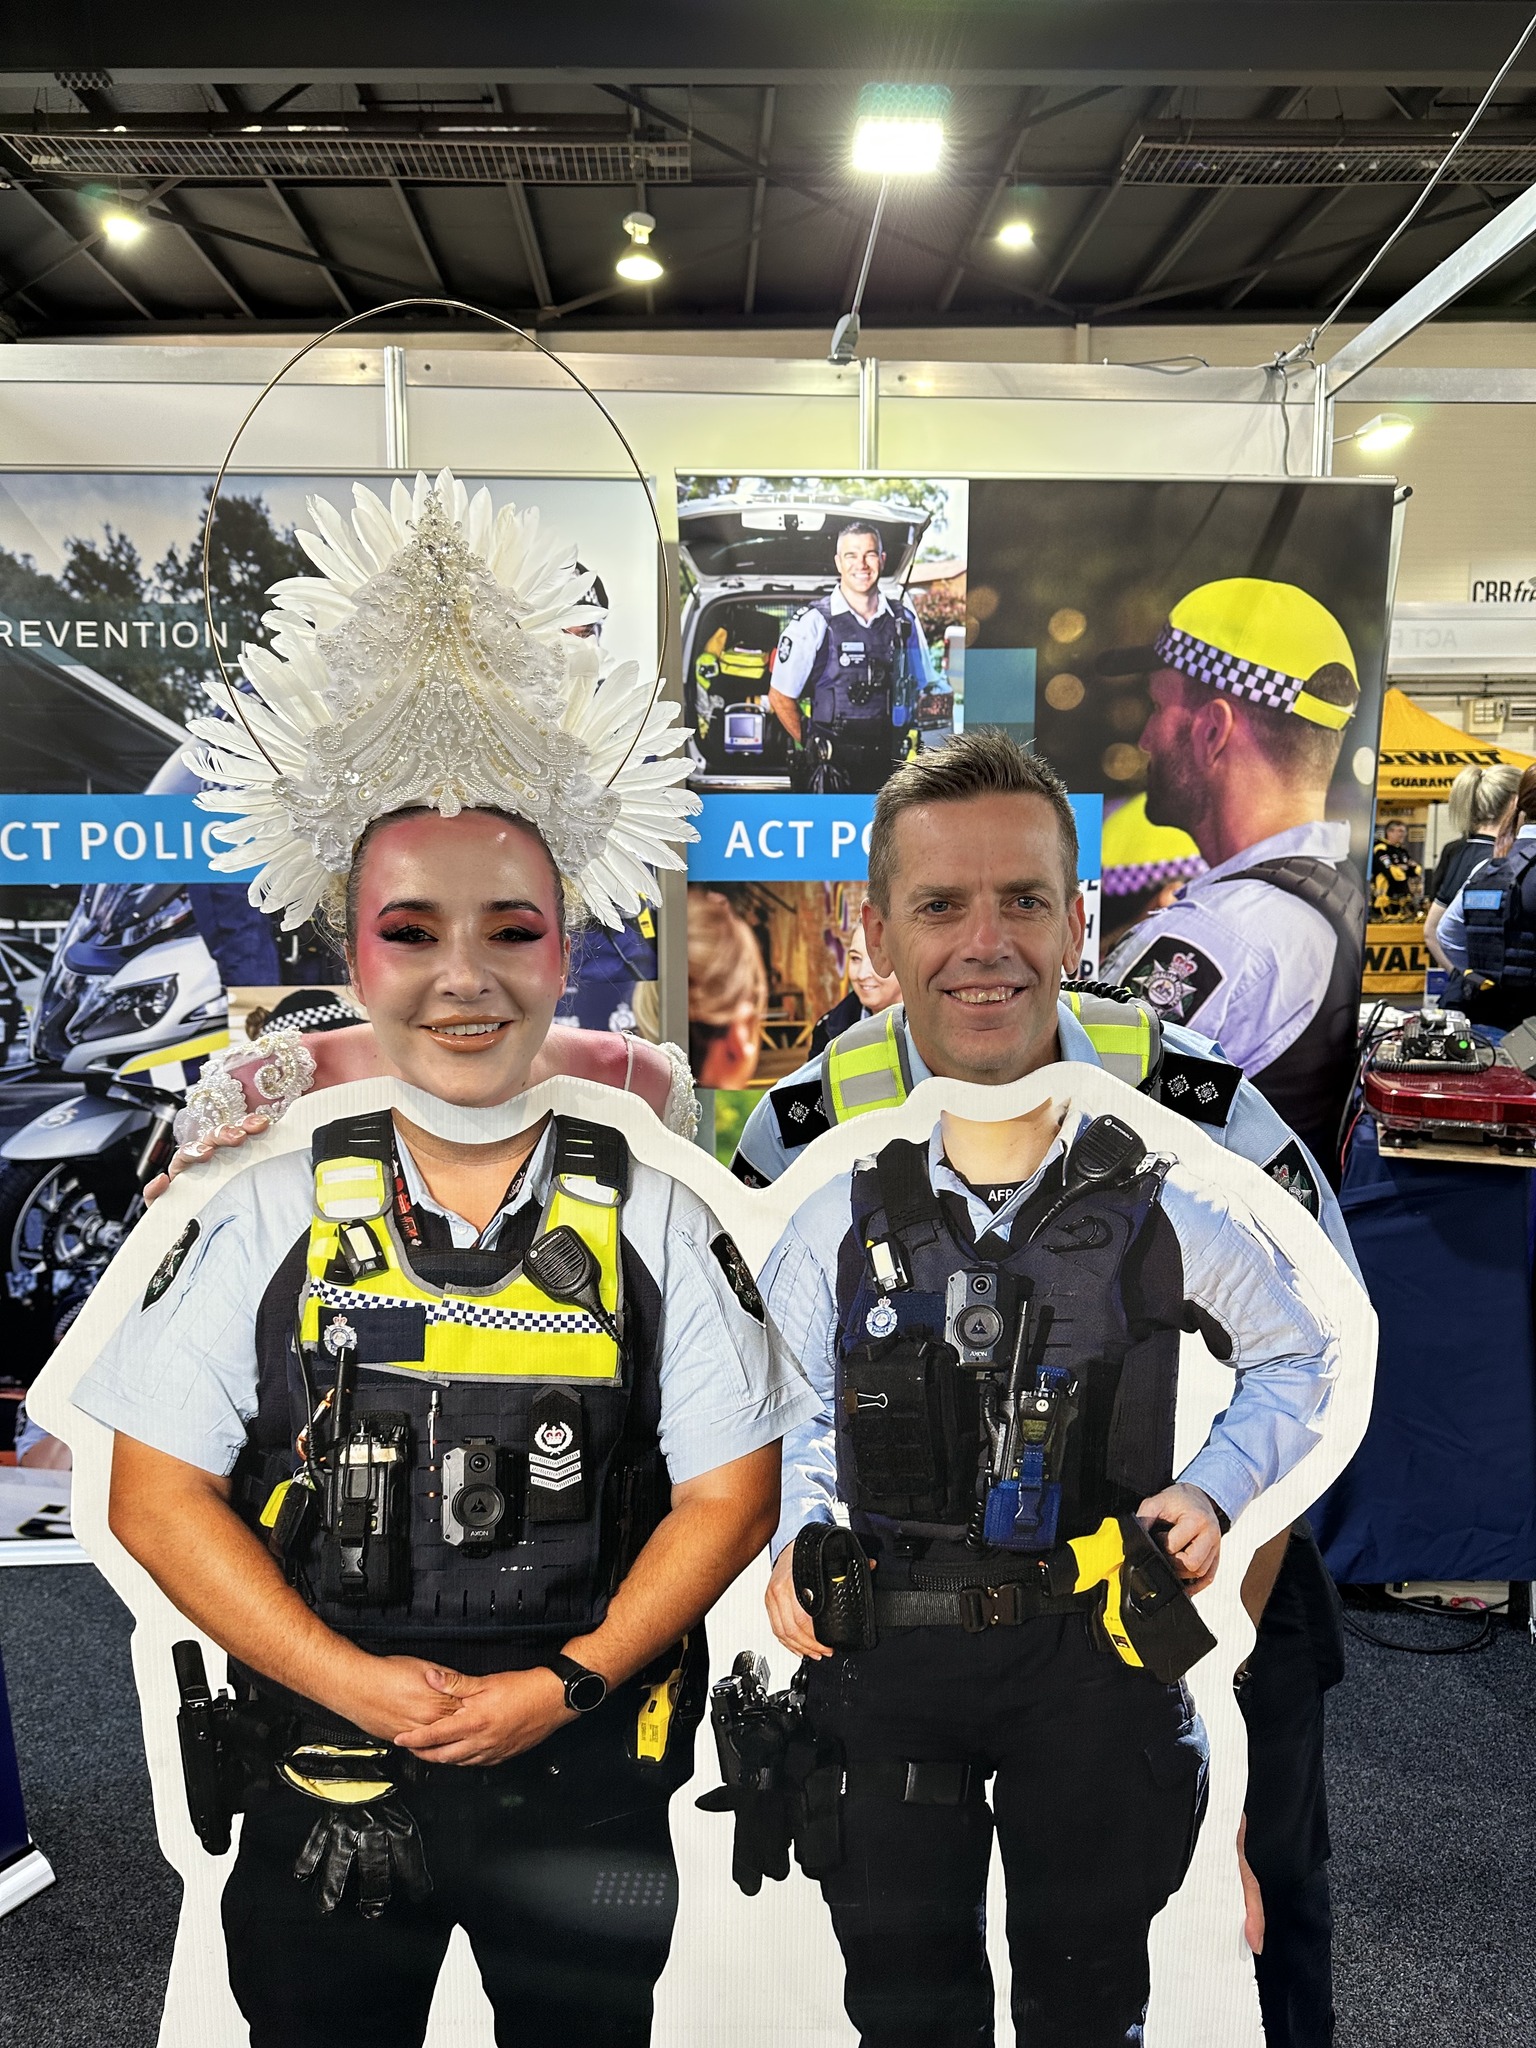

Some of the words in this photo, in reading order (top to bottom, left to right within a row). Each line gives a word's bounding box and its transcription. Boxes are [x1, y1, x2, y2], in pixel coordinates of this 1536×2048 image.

[0, 620, 228, 648] REVENTION
[0, 821, 60, 861] CT
[724, 820, 814, 859] ACT
[987, 1188, 1014, 1202] AFP
